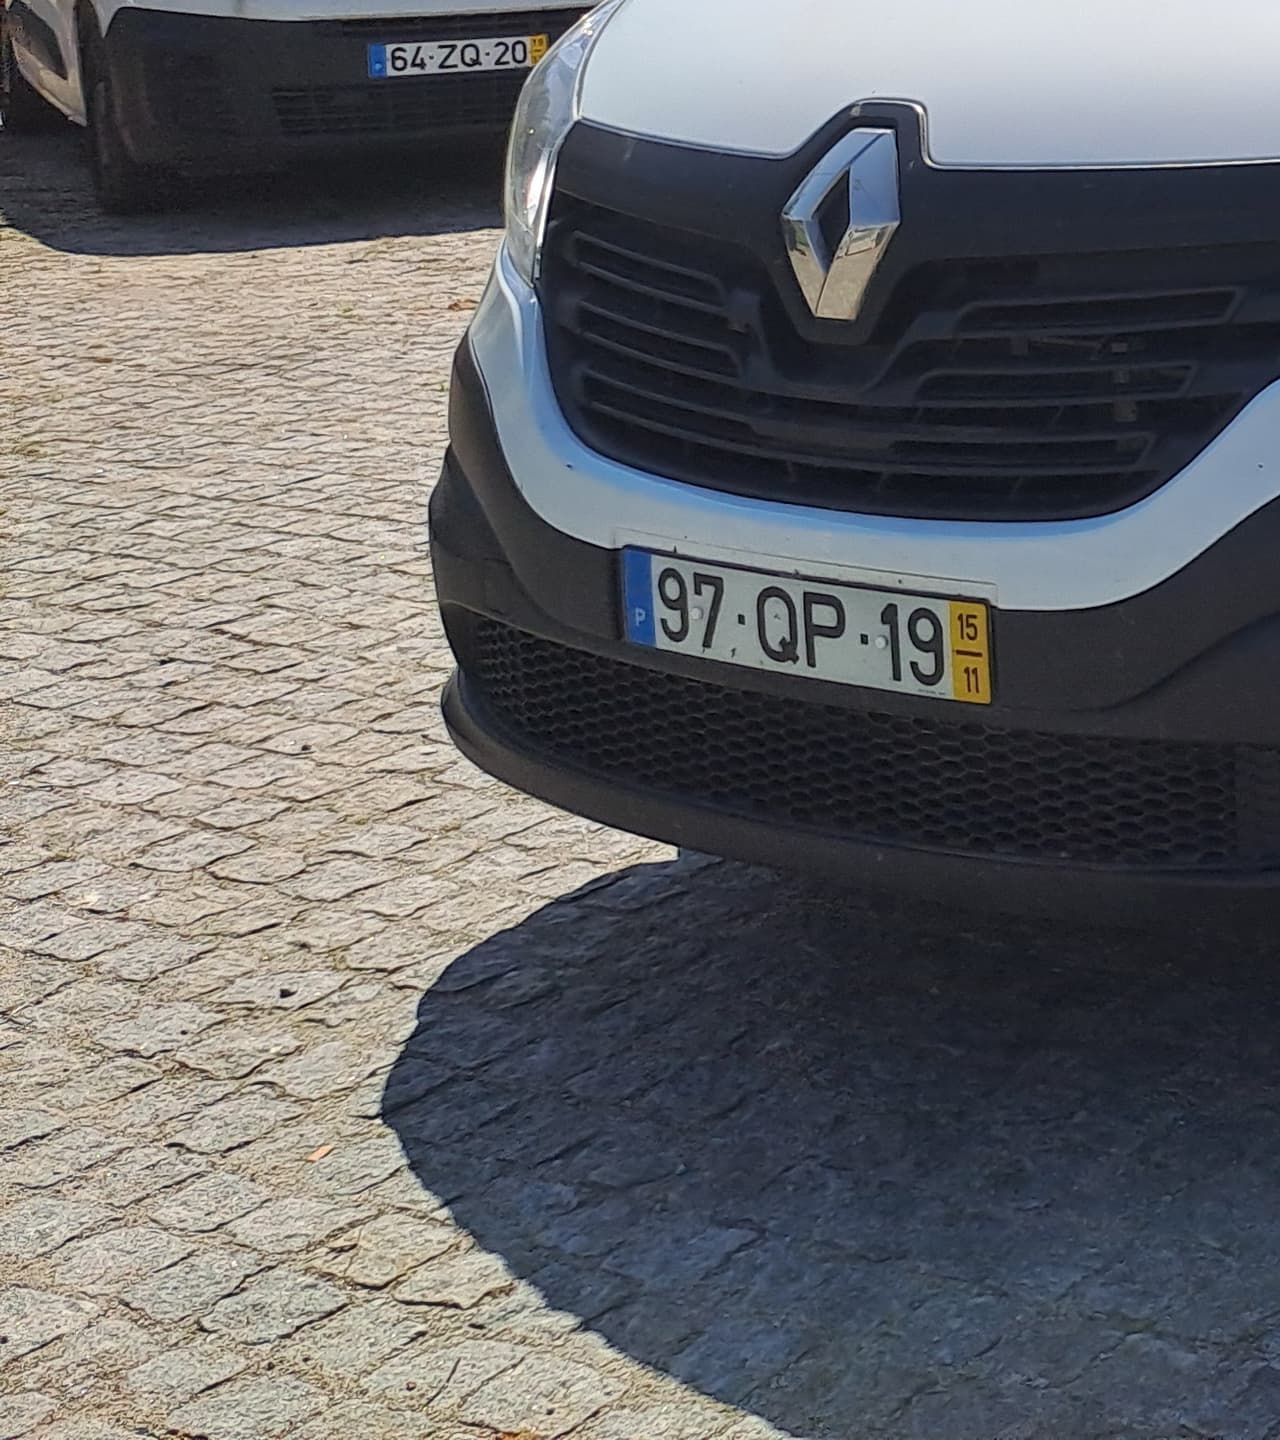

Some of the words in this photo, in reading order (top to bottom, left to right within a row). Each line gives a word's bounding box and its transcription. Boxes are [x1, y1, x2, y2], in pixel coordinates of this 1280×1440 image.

[633, 608, 647, 628] P
[957, 613, 978, 641] 15
[963, 666, 980, 694] 11
